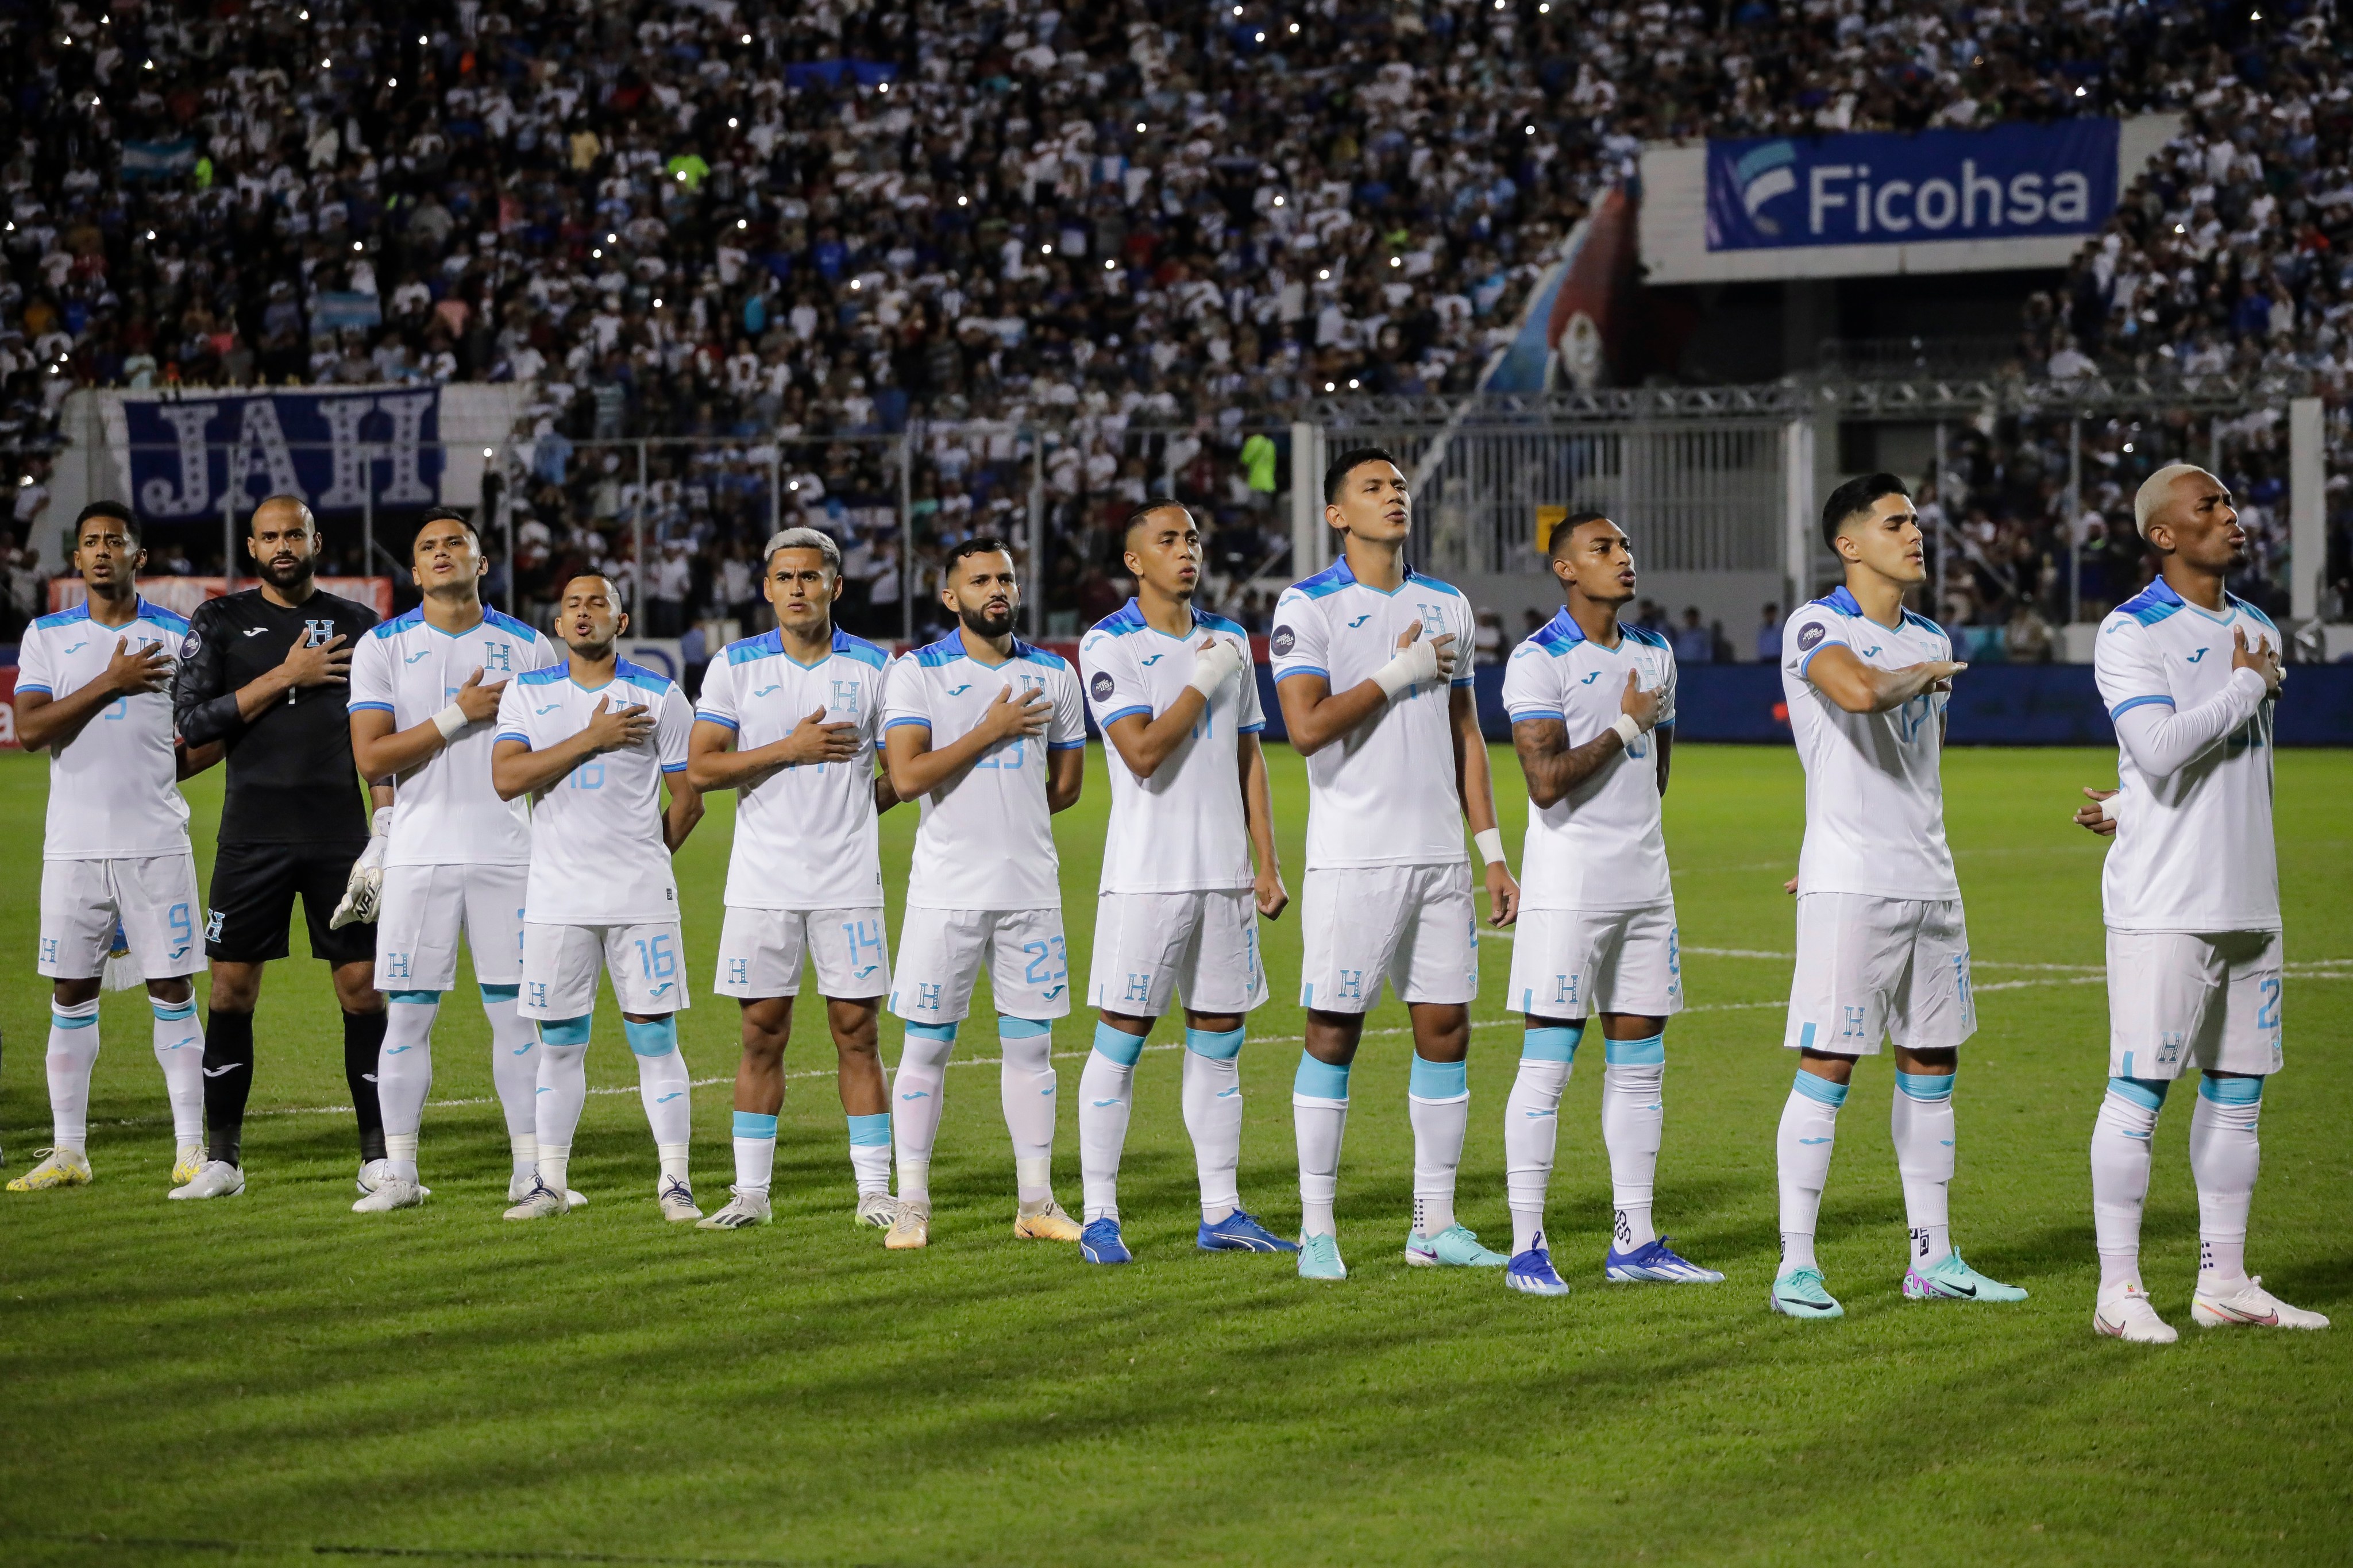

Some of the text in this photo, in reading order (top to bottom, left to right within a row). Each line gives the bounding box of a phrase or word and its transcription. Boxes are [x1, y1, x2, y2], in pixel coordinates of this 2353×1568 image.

[1810, 159, 2089, 234] Ficohsa
[141, 392, 434, 517] JAH
[305, 620, 334, 647] H
[1416, 603, 1446, 635] H
[484, 642, 512, 671] H
[830, 680, 859, 713] H
[168, 902, 192, 944] 9
[205, 908, 226, 943] H
[40, 937, 58, 963] H
[634, 934, 675, 979] 16
[842, 918, 882, 965] 14
[388, 953, 410, 977] H
[728, 958, 748, 984] H
[1024, 935, 1067, 984] 23
[528, 981, 547, 1007] H
[917, 983, 941, 1010] H
[1124, 973, 1151, 1001] H
[1338, 970, 1362, 998] H
[1555, 975, 1578, 1003] H
[2258, 978, 2279, 1029] 2
[1842, 1006, 1865, 1037] H
